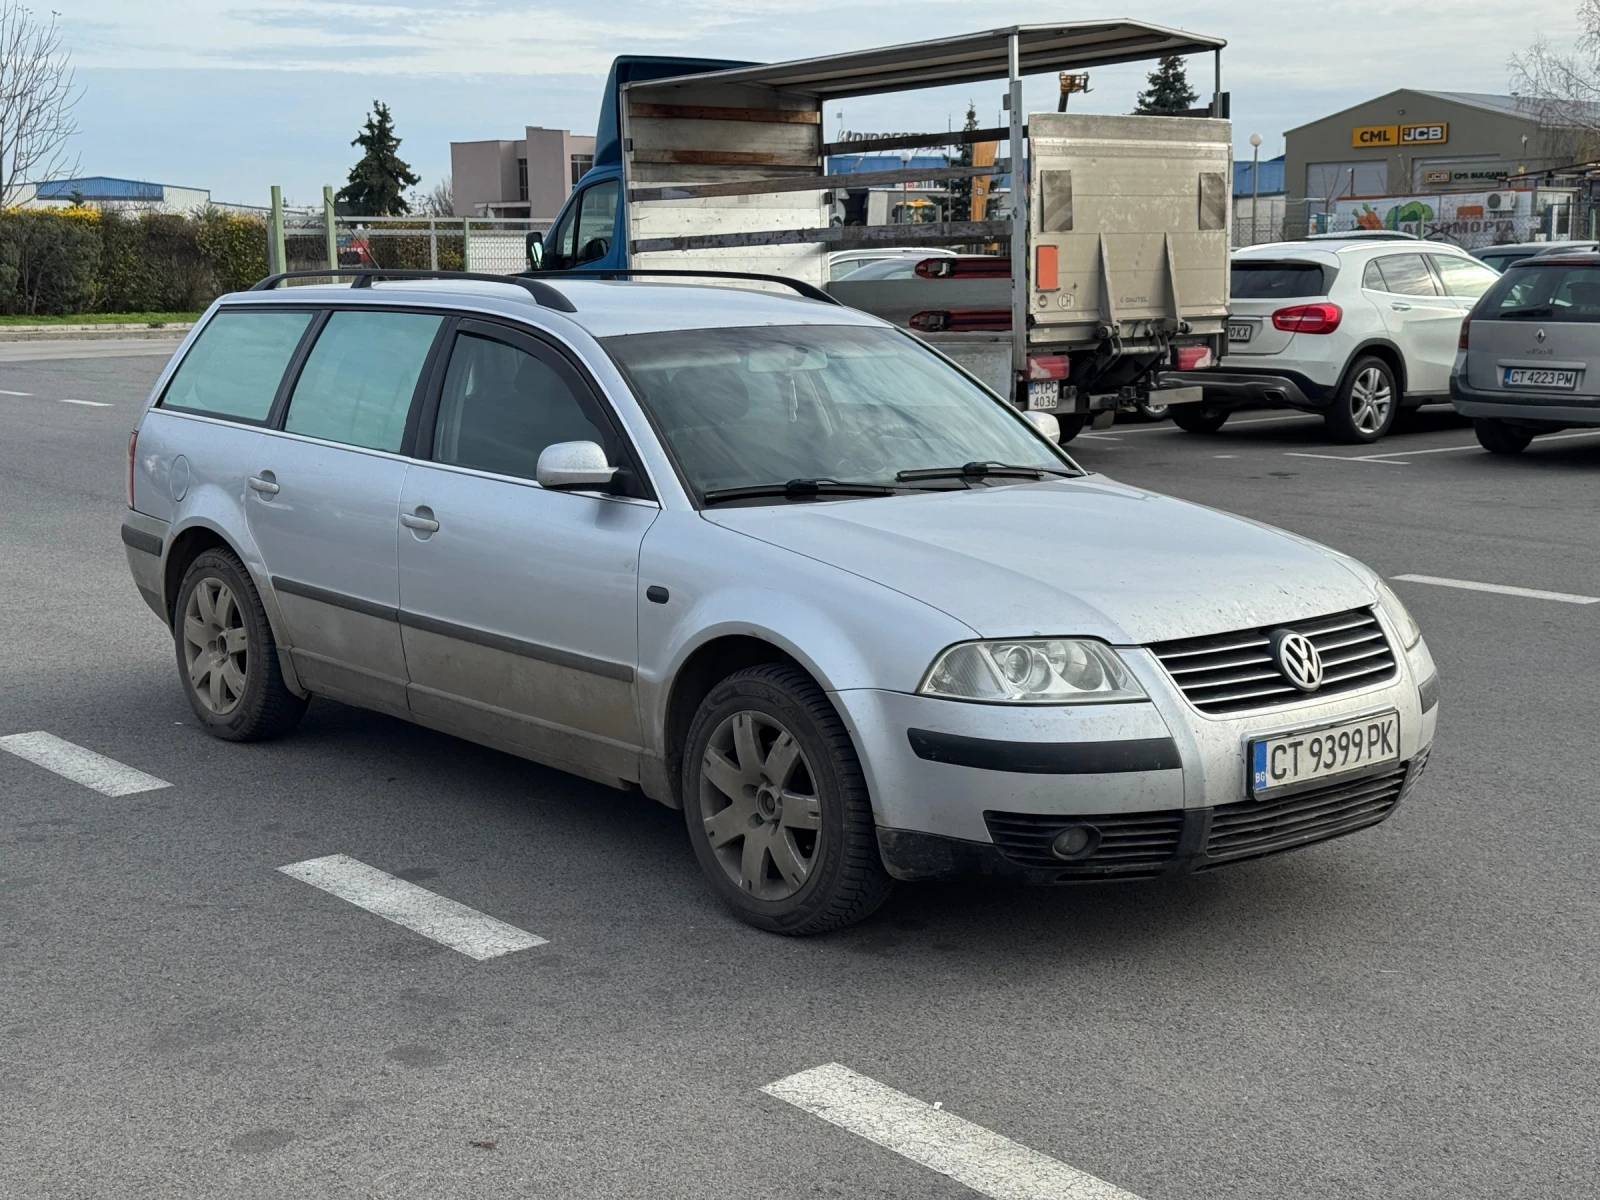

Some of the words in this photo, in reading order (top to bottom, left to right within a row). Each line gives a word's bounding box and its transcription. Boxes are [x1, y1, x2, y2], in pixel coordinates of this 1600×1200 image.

[1360, 130, 1390, 142] CML
[1403, 127, 1441, 140] JCB
[1061, 295, 1072, 308] CH
[1033, 395, 1057, 408] 4036
[1255, 771, 1266, 783] BG
